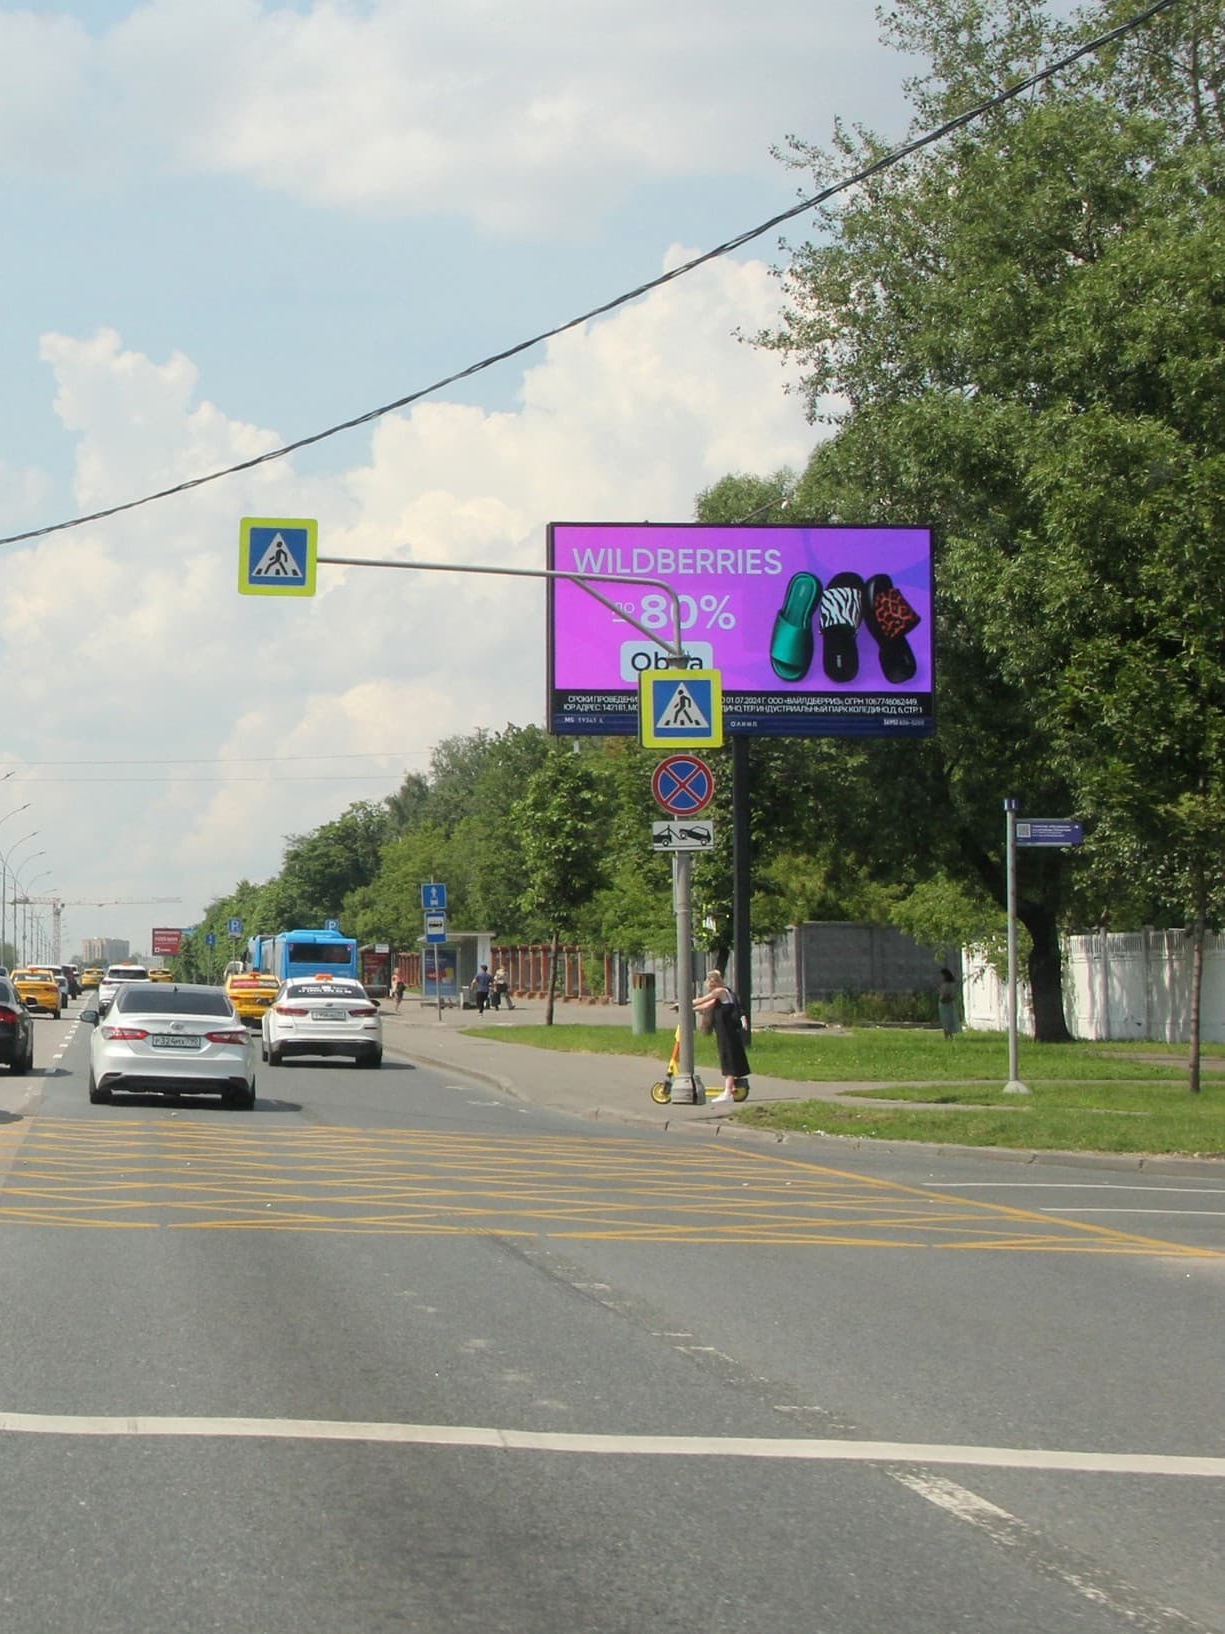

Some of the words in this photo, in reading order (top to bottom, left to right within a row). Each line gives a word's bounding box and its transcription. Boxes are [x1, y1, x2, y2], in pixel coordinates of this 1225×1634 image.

[573, 548, 783, 575] WILDBERRIES
[640, 594, 736, 630] 80%
[631, 651, 703, 671] Oba
[768, 697, 783, 705] ООО
